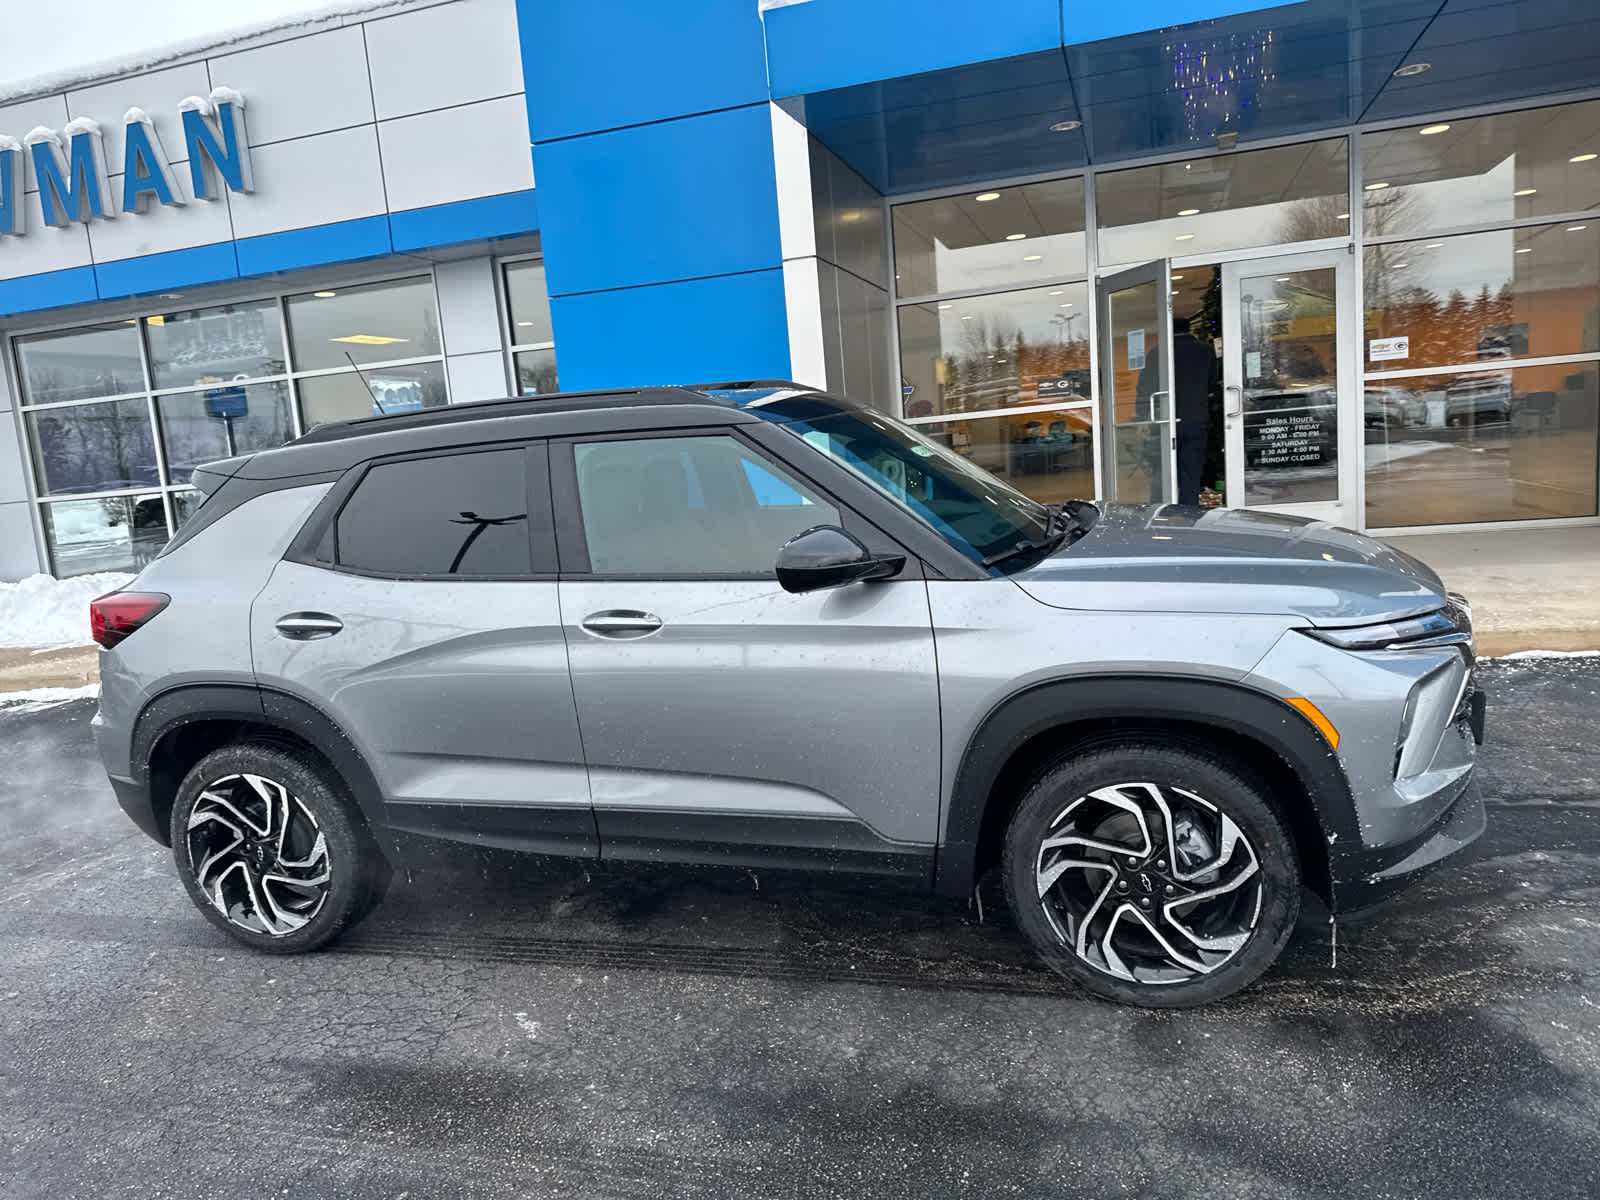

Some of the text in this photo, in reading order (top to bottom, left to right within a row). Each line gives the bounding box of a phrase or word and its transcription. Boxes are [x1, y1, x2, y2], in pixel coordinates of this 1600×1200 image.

[1266, 416, 1314, 425] Sales Hours
[1259, 426, 1289, 434] MONDAY
[1271, 439, 1309, 448] SATURDAY
[1261, 456, 1290, 464] SUNDAY
